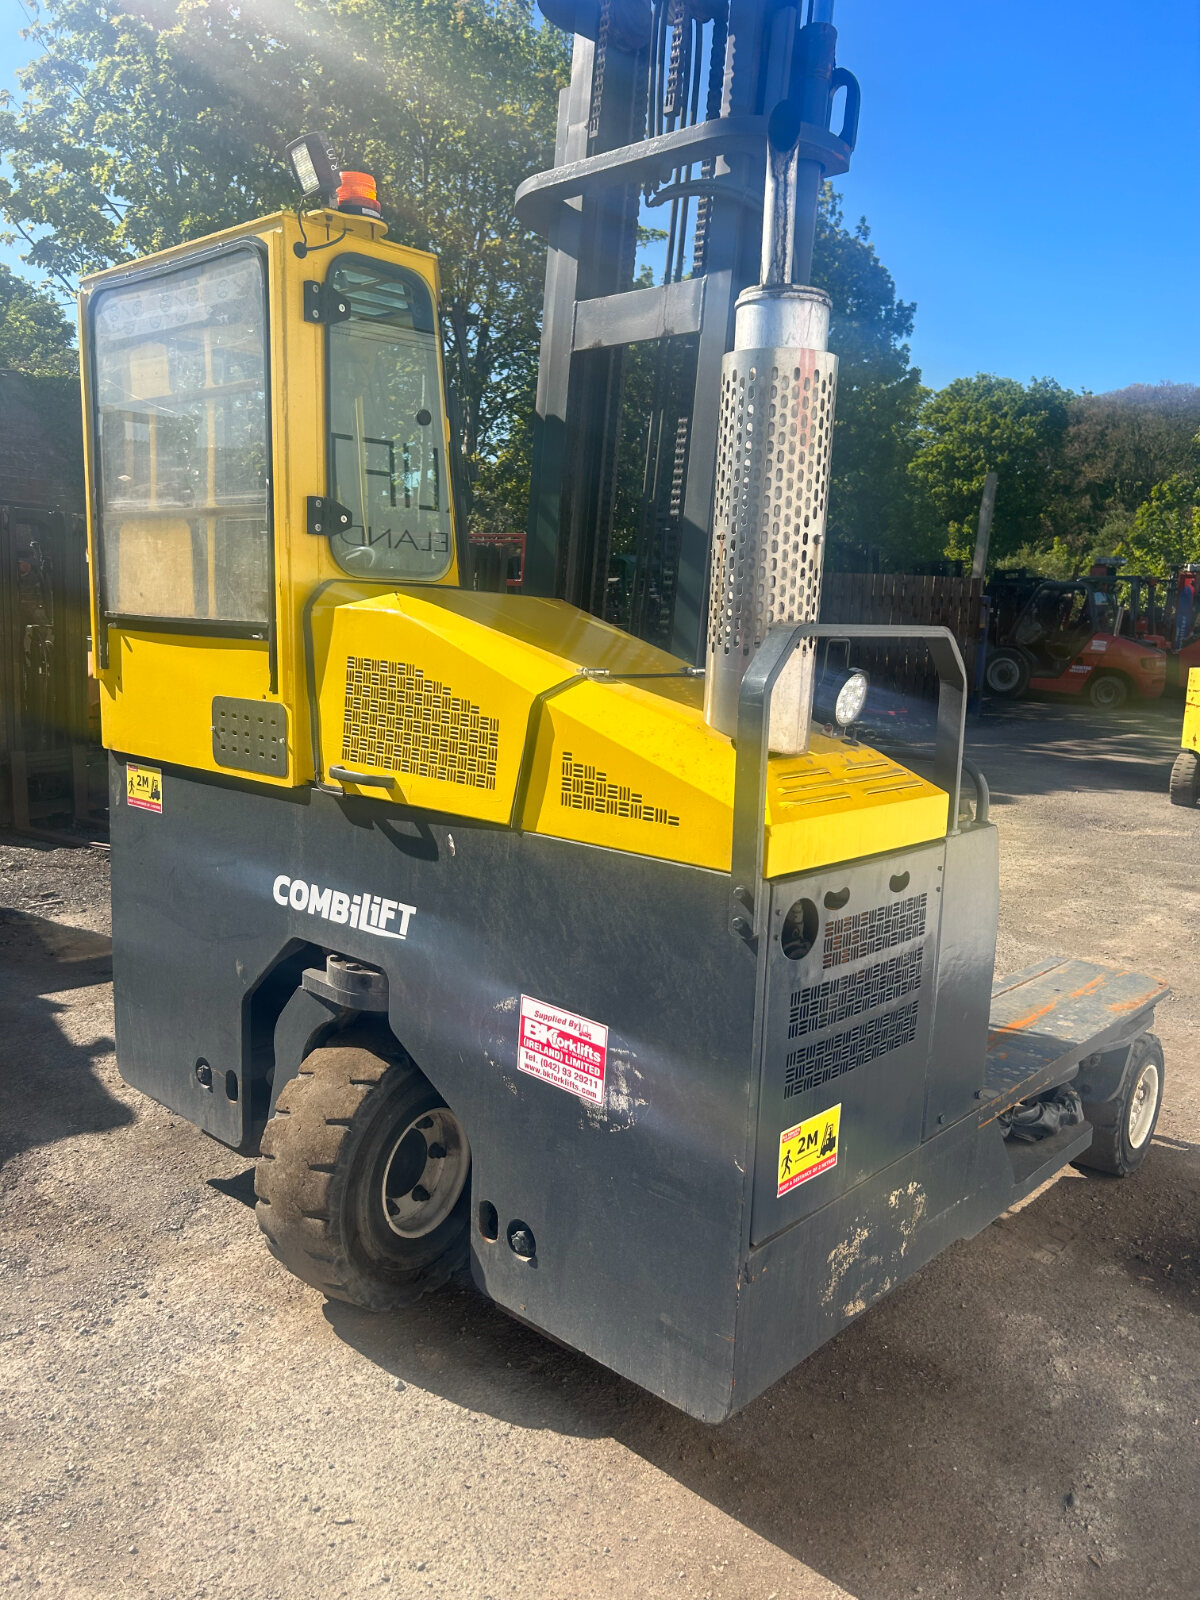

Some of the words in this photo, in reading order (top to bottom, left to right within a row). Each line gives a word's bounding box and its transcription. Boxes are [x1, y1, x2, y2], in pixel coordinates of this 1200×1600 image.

[137, 775, 149, 788] 2M
[534, 1010, 567, 1026] Supplied
[523, 1036, 563, 1062] (IRELAND)
[565, 1054, 600, 1077] LIMITED
[524, 1050, 538, 1063] Tel.
[540, 1057, 560, 1074] (042)
[562, 1066, 572, 1078] 93
[573, 1072, 597, 1089] 29211
[524, 1062, 597, 1099] www.bkforklifts.com
[797, 1130, 818, 1154] 2M
